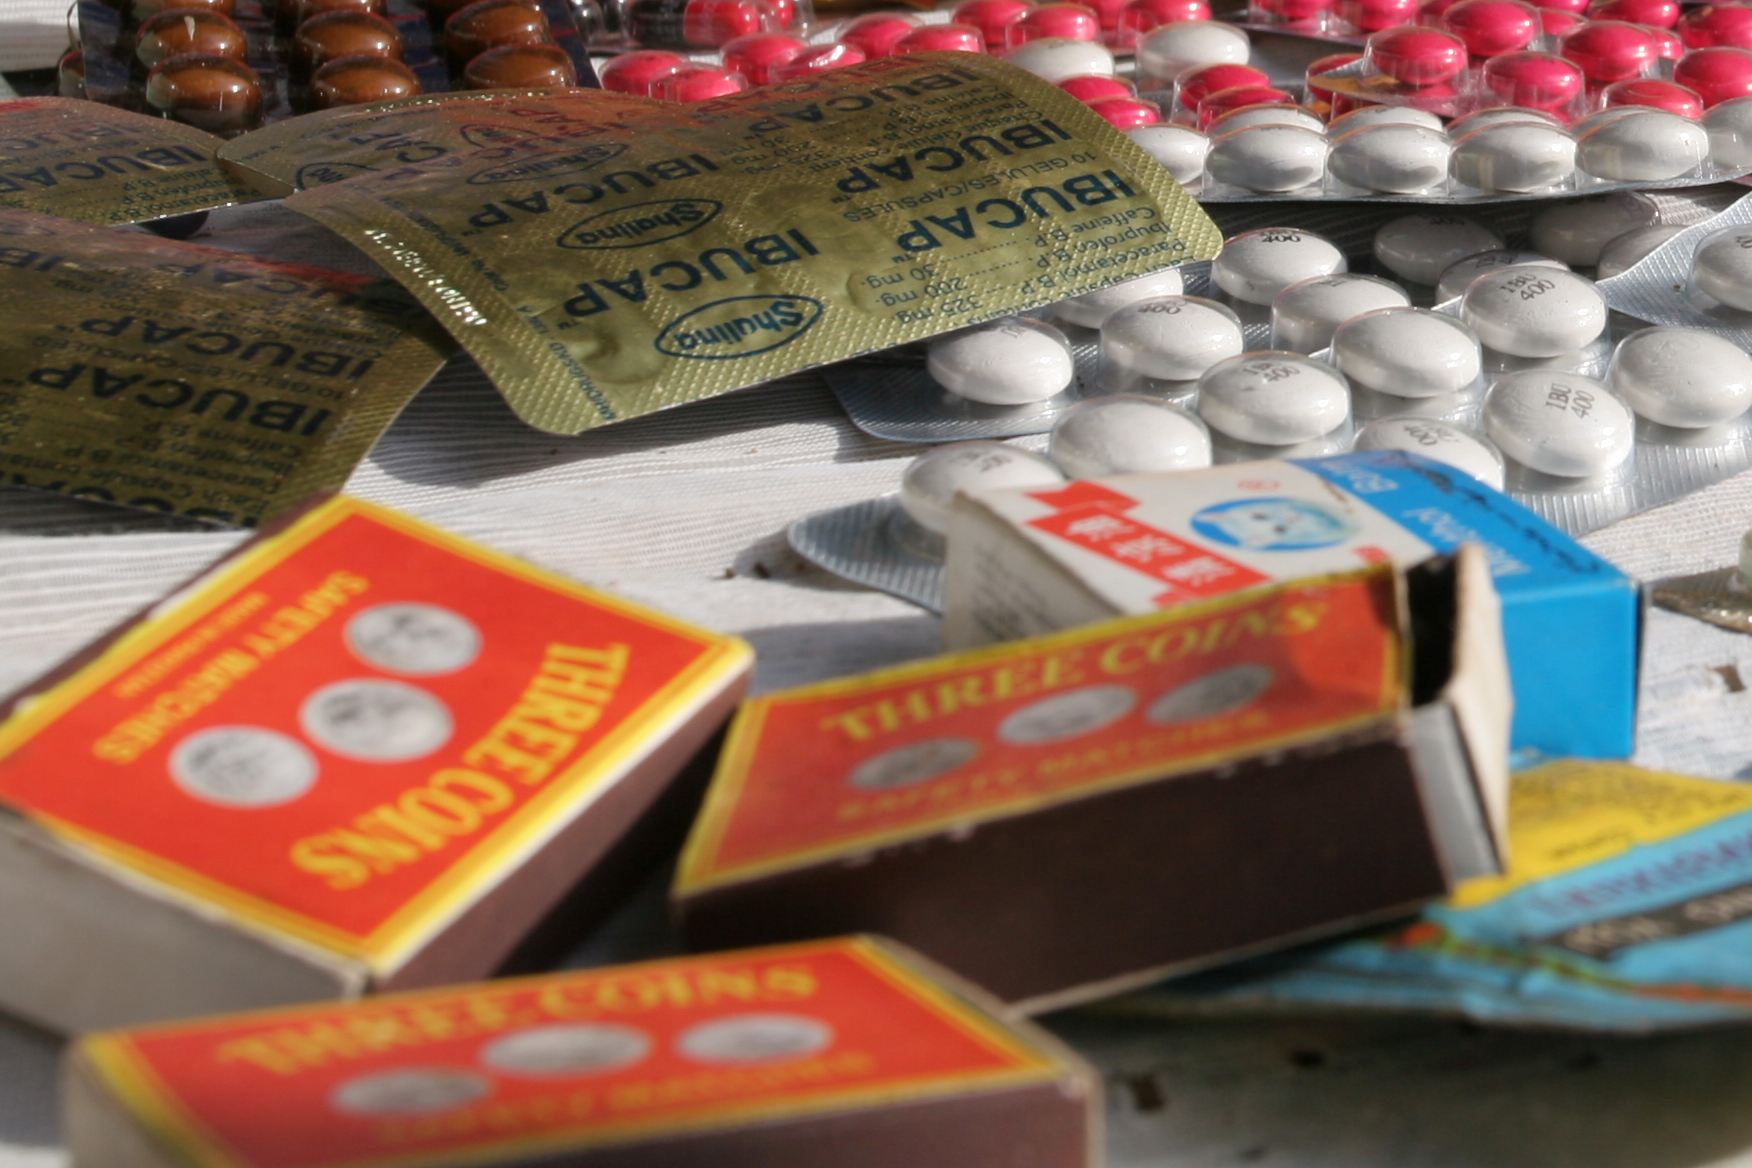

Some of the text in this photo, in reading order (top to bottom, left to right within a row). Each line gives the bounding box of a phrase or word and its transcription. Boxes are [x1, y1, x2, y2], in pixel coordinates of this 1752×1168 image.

[750, 68, 979, 135] IBUCAP
[835, 118, 1073, 194] IBUCAP
[842, 151, 1097, 223] 10 GELULES/CAPSULES
[466, 152, 720, 229] IBUCAP
[574, 201, 705, 246] Shalina
[897, 168, 1139, 253] IBUCAP
[1075, 205, 1156, 234] Caffeine
[561, 227, 820, 318] IBUCAP
[1064, 239, 1188, 284] Paracetamol
[1071, 221, 1171, 258] Ibuprofen
[908, 262, 938, 284] 30
[917, 274, 969, 298] 200
[951, 293, 984, 316] 325
[1499, 271, 1538, 296] IBU
[1519, 278, 1557, 302] 400
[79, 315, 376, 381] IBUCAP
[675, 302, 804, 352] Shalina
[26, 362, 333, 437] IBUCAP
[1544, 382, 1573, 413] IBU
[1572, 389, 1597, 420] 400
[242, 569, 371, 661] SAFETY
[821, 601, 1331, 743] THREE COINS
[289, 640, 632, 891] THREE COINS
[1038, 710, 1275, 778] MATCHES
[213, 964, 821, 1076] THREE COINS
